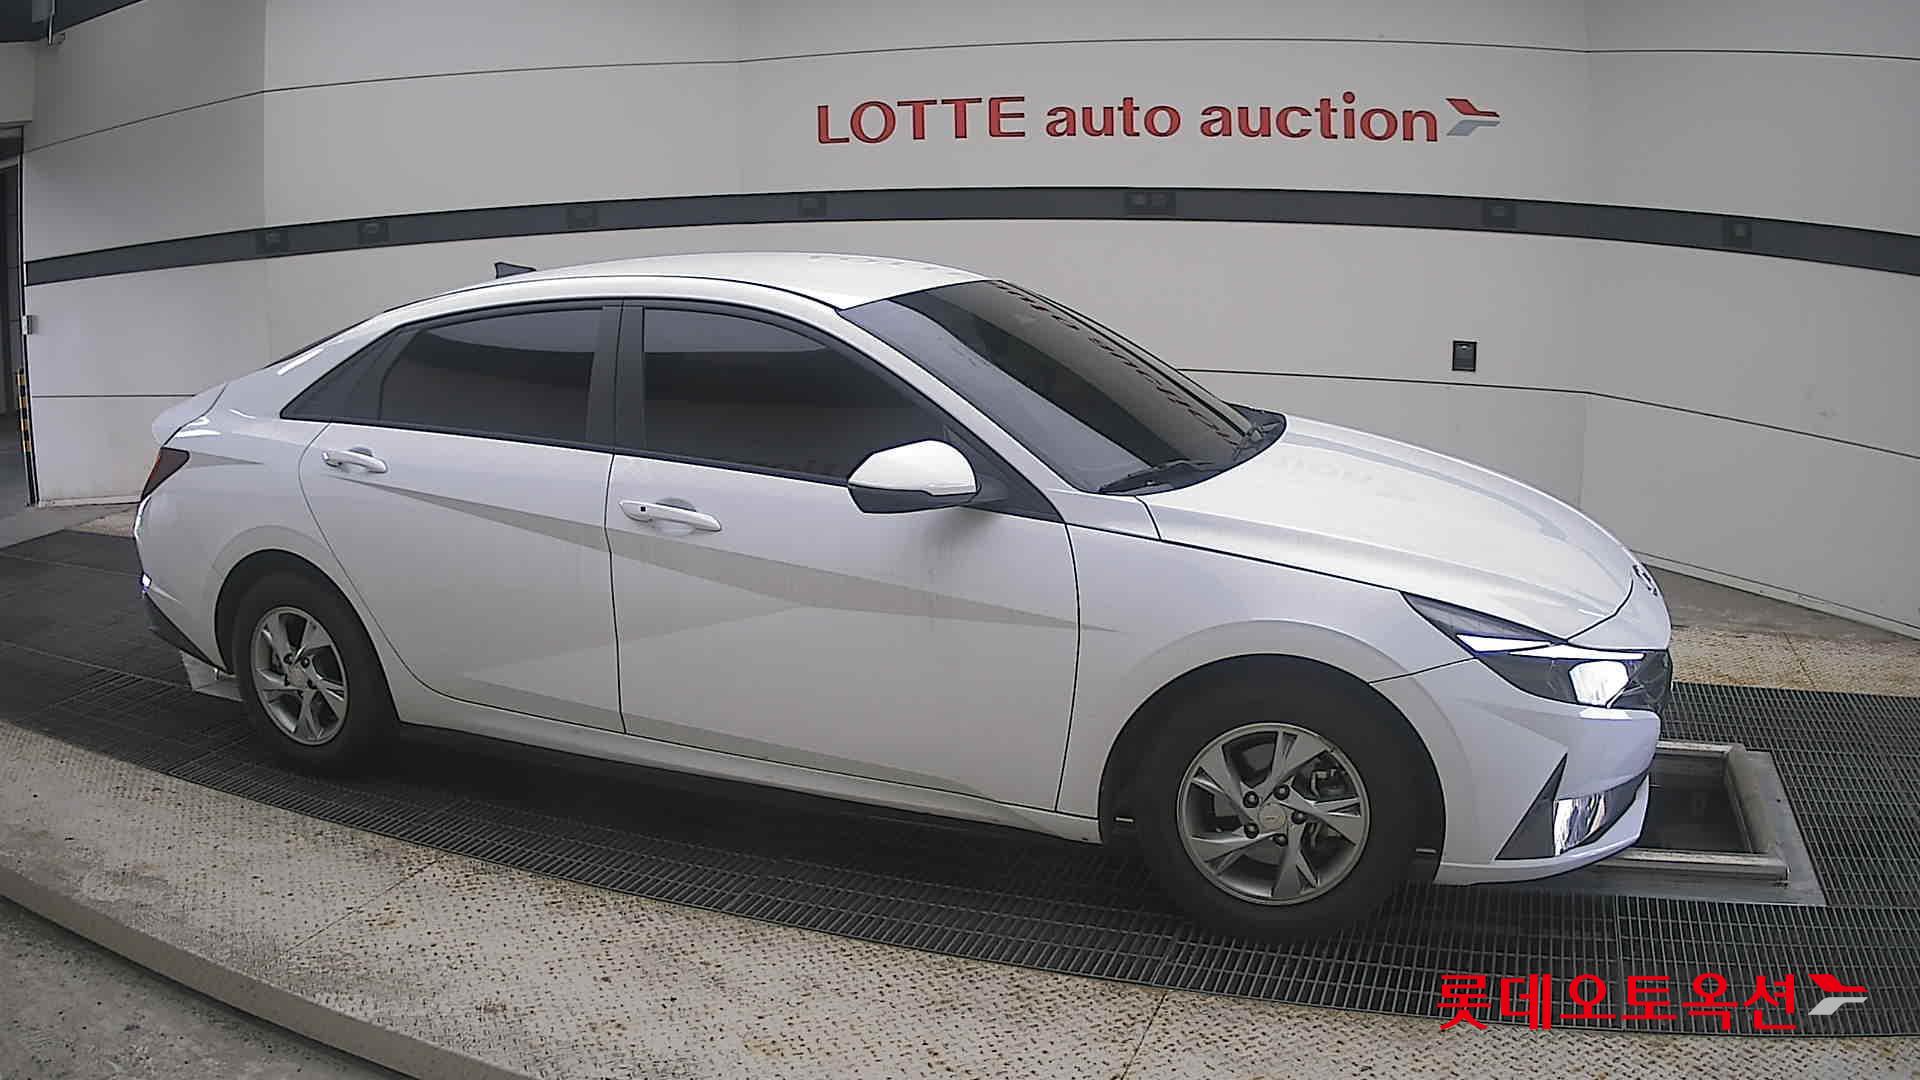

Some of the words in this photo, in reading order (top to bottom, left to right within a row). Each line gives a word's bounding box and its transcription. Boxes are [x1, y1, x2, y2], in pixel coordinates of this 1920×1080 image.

[816, 97, 1025, 145] LOTTE
[1045, 97, 1182, 138] auto
[1200, 92, 1439, 142] auction
